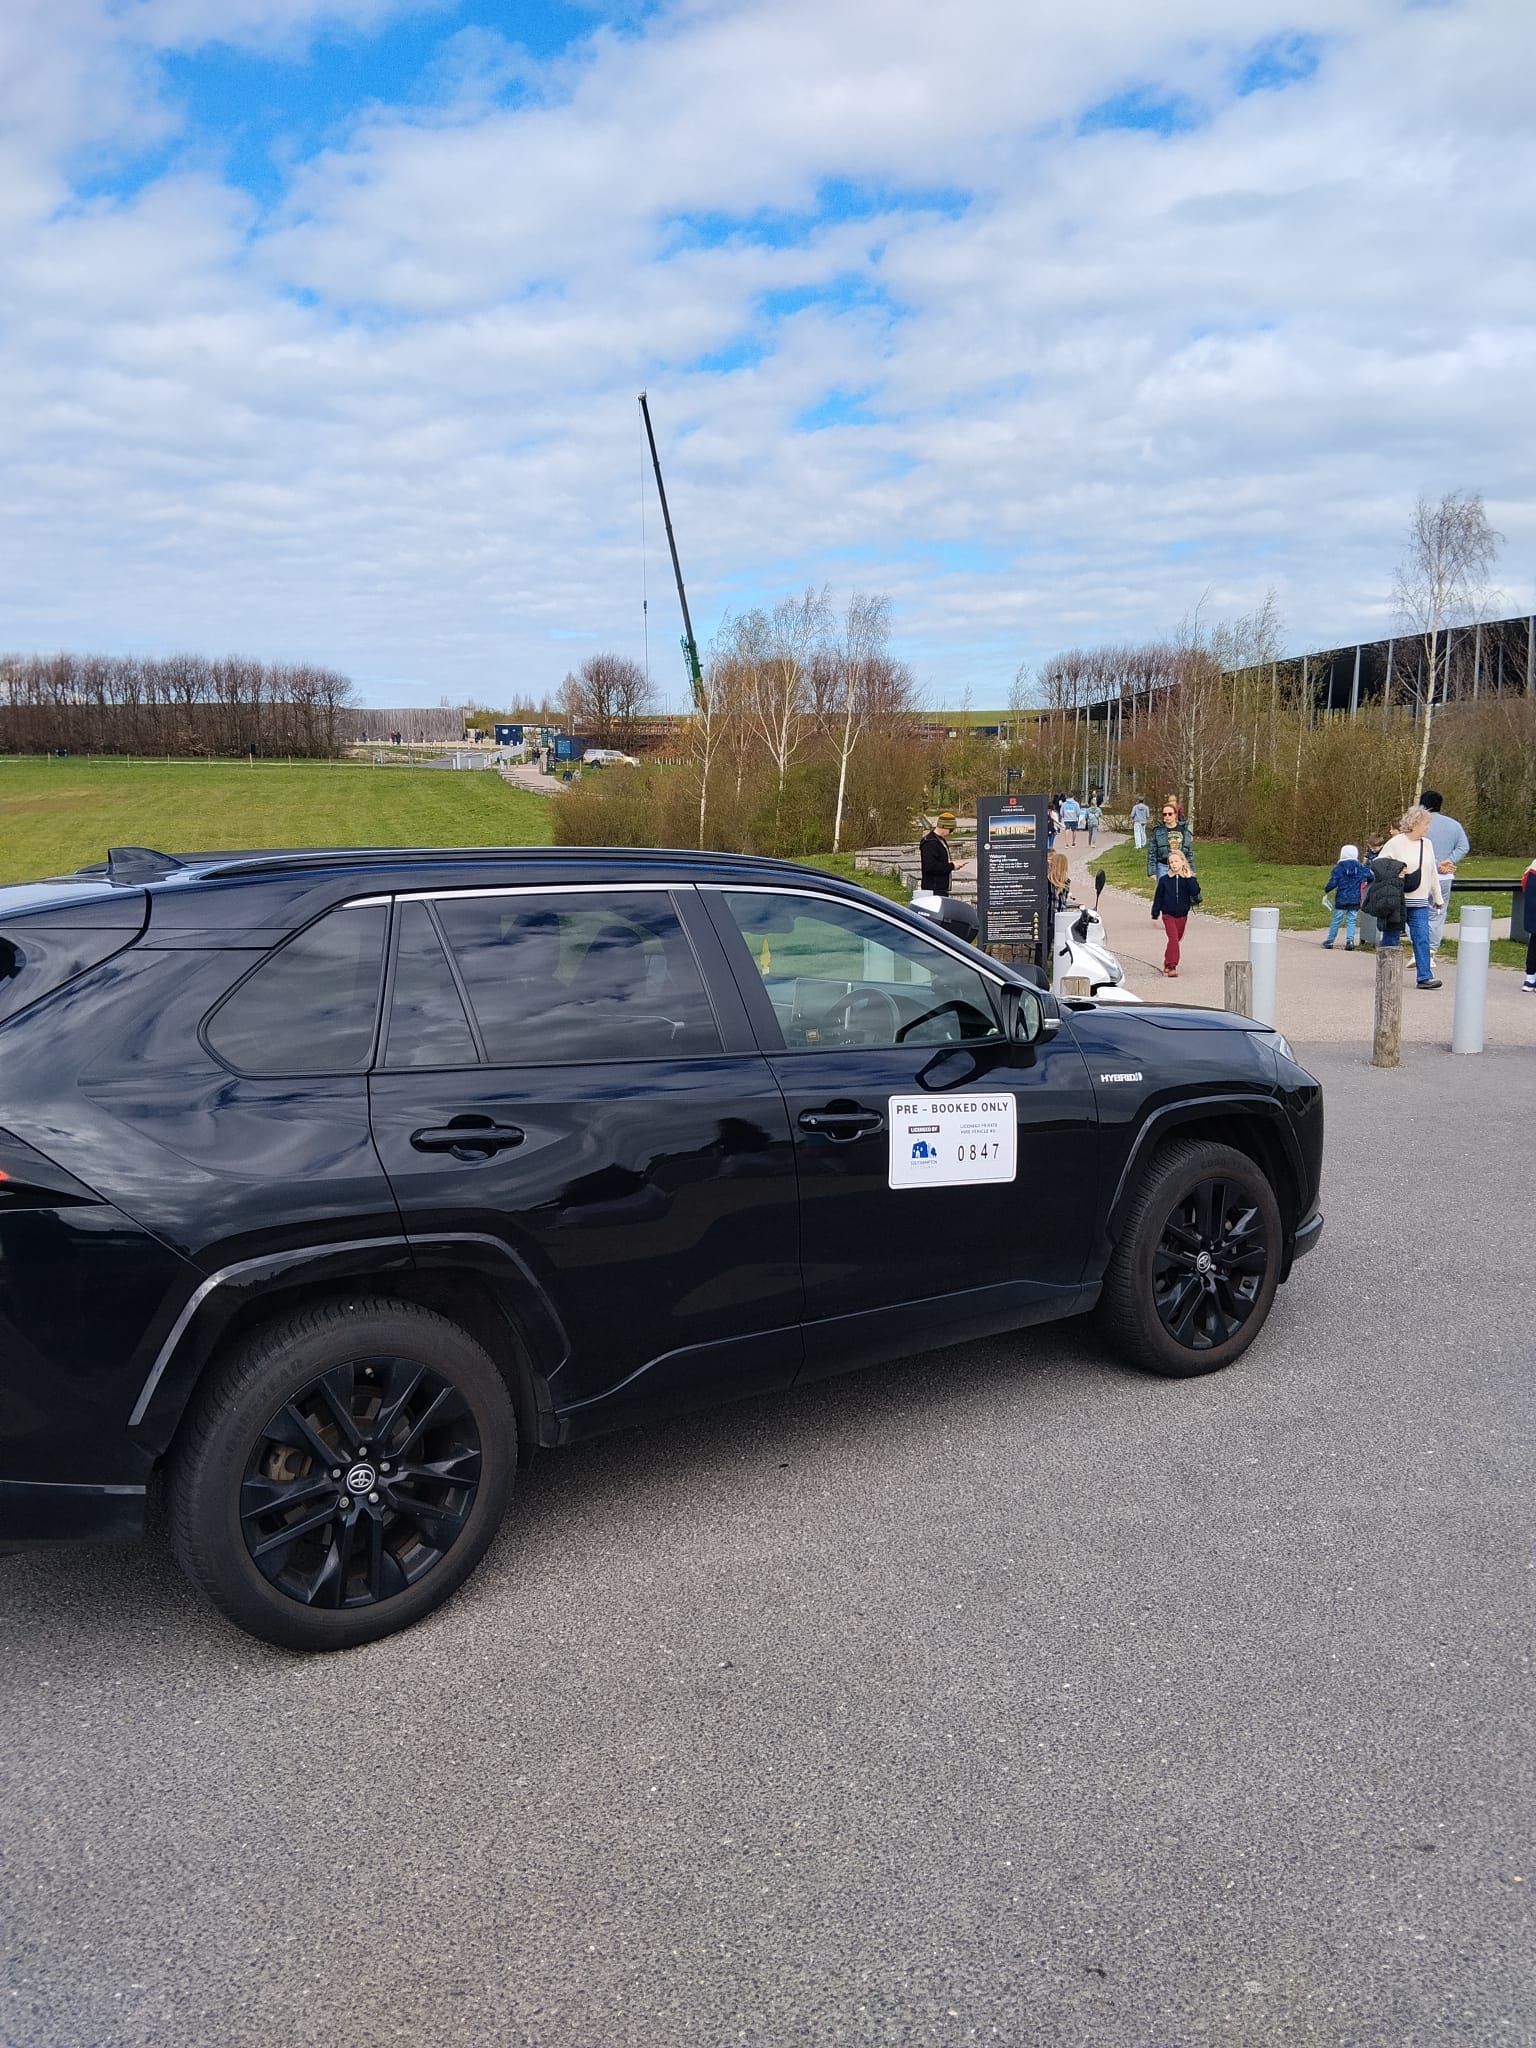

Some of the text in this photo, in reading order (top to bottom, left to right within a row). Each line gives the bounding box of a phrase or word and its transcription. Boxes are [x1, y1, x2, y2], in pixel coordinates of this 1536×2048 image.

[1101, 1073, 1136, 1082] HYBRID
[896, 1104, 919, 1115] PRE
[931, 1103, 978, 1114] BOOKED
[981, 1102, 1009, 1113] ONLY
[957, 1143, 999, 1161] 0847
